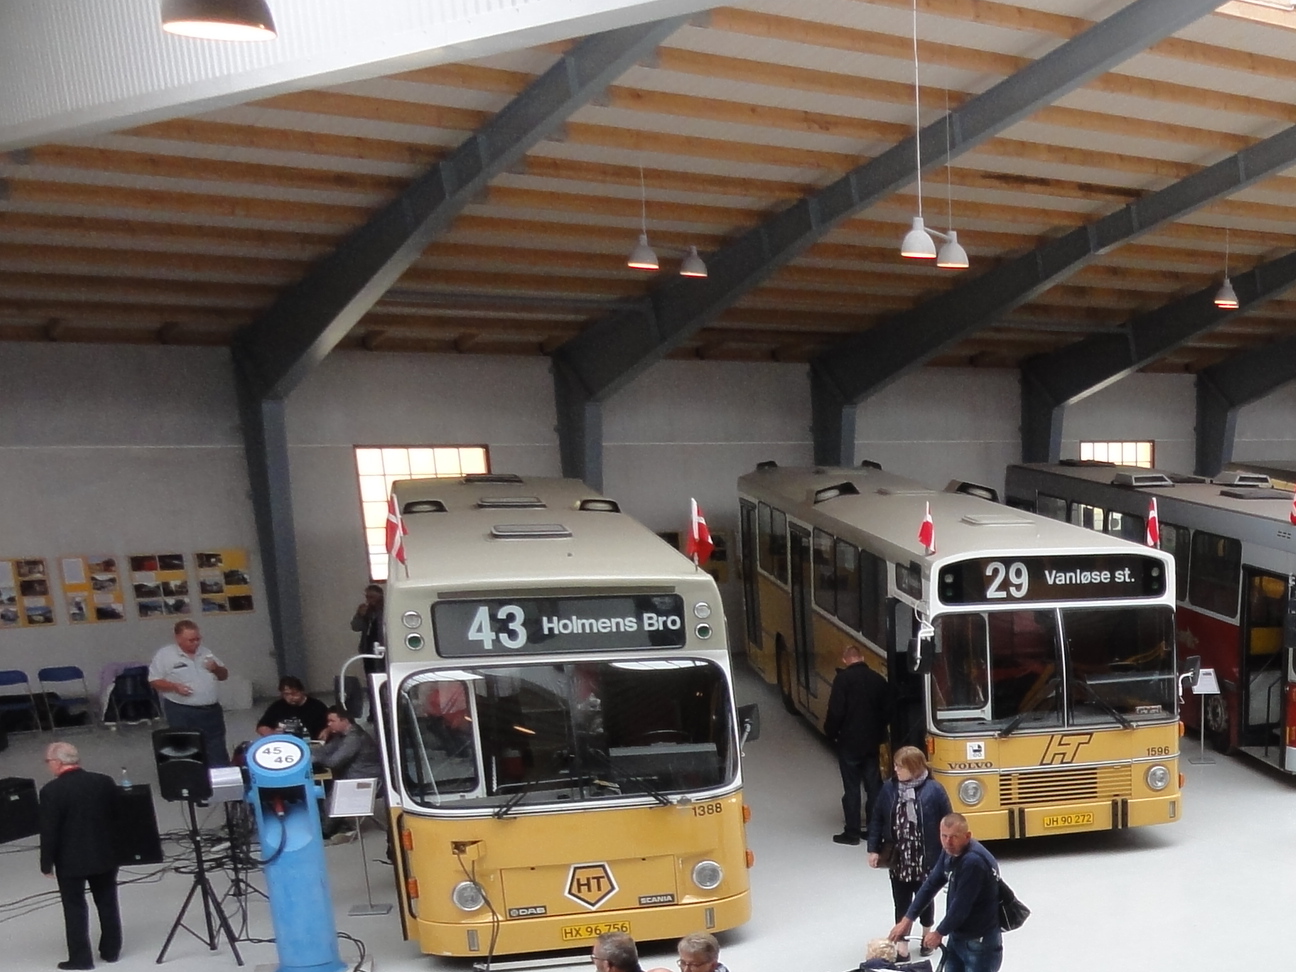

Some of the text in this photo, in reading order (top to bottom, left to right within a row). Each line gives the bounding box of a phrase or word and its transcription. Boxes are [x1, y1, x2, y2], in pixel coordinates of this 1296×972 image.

[985, 561, 1029, 599] 29
[1044, 567, 1135, 586] Vanløse st.
[468, 604, 528, 650] 43
[542, 612, 681, 635] Holmens Bro
[262, 746, 282, 755] 45
[1146, 746, 1171, 756] 1596
[274, 755, 294, 764] 46
[948, 761, 993, 770] VOLVO
[692, 802, 723, 817] 1388
[1046, 814, 1092, 826] JH 90 272
[575, 875, 606, 894] HT
[640, 895, 673, 904] SCANIA
[519, 907, 546, 915] DAB
[564, 923, 629, 939] HX 96 756
